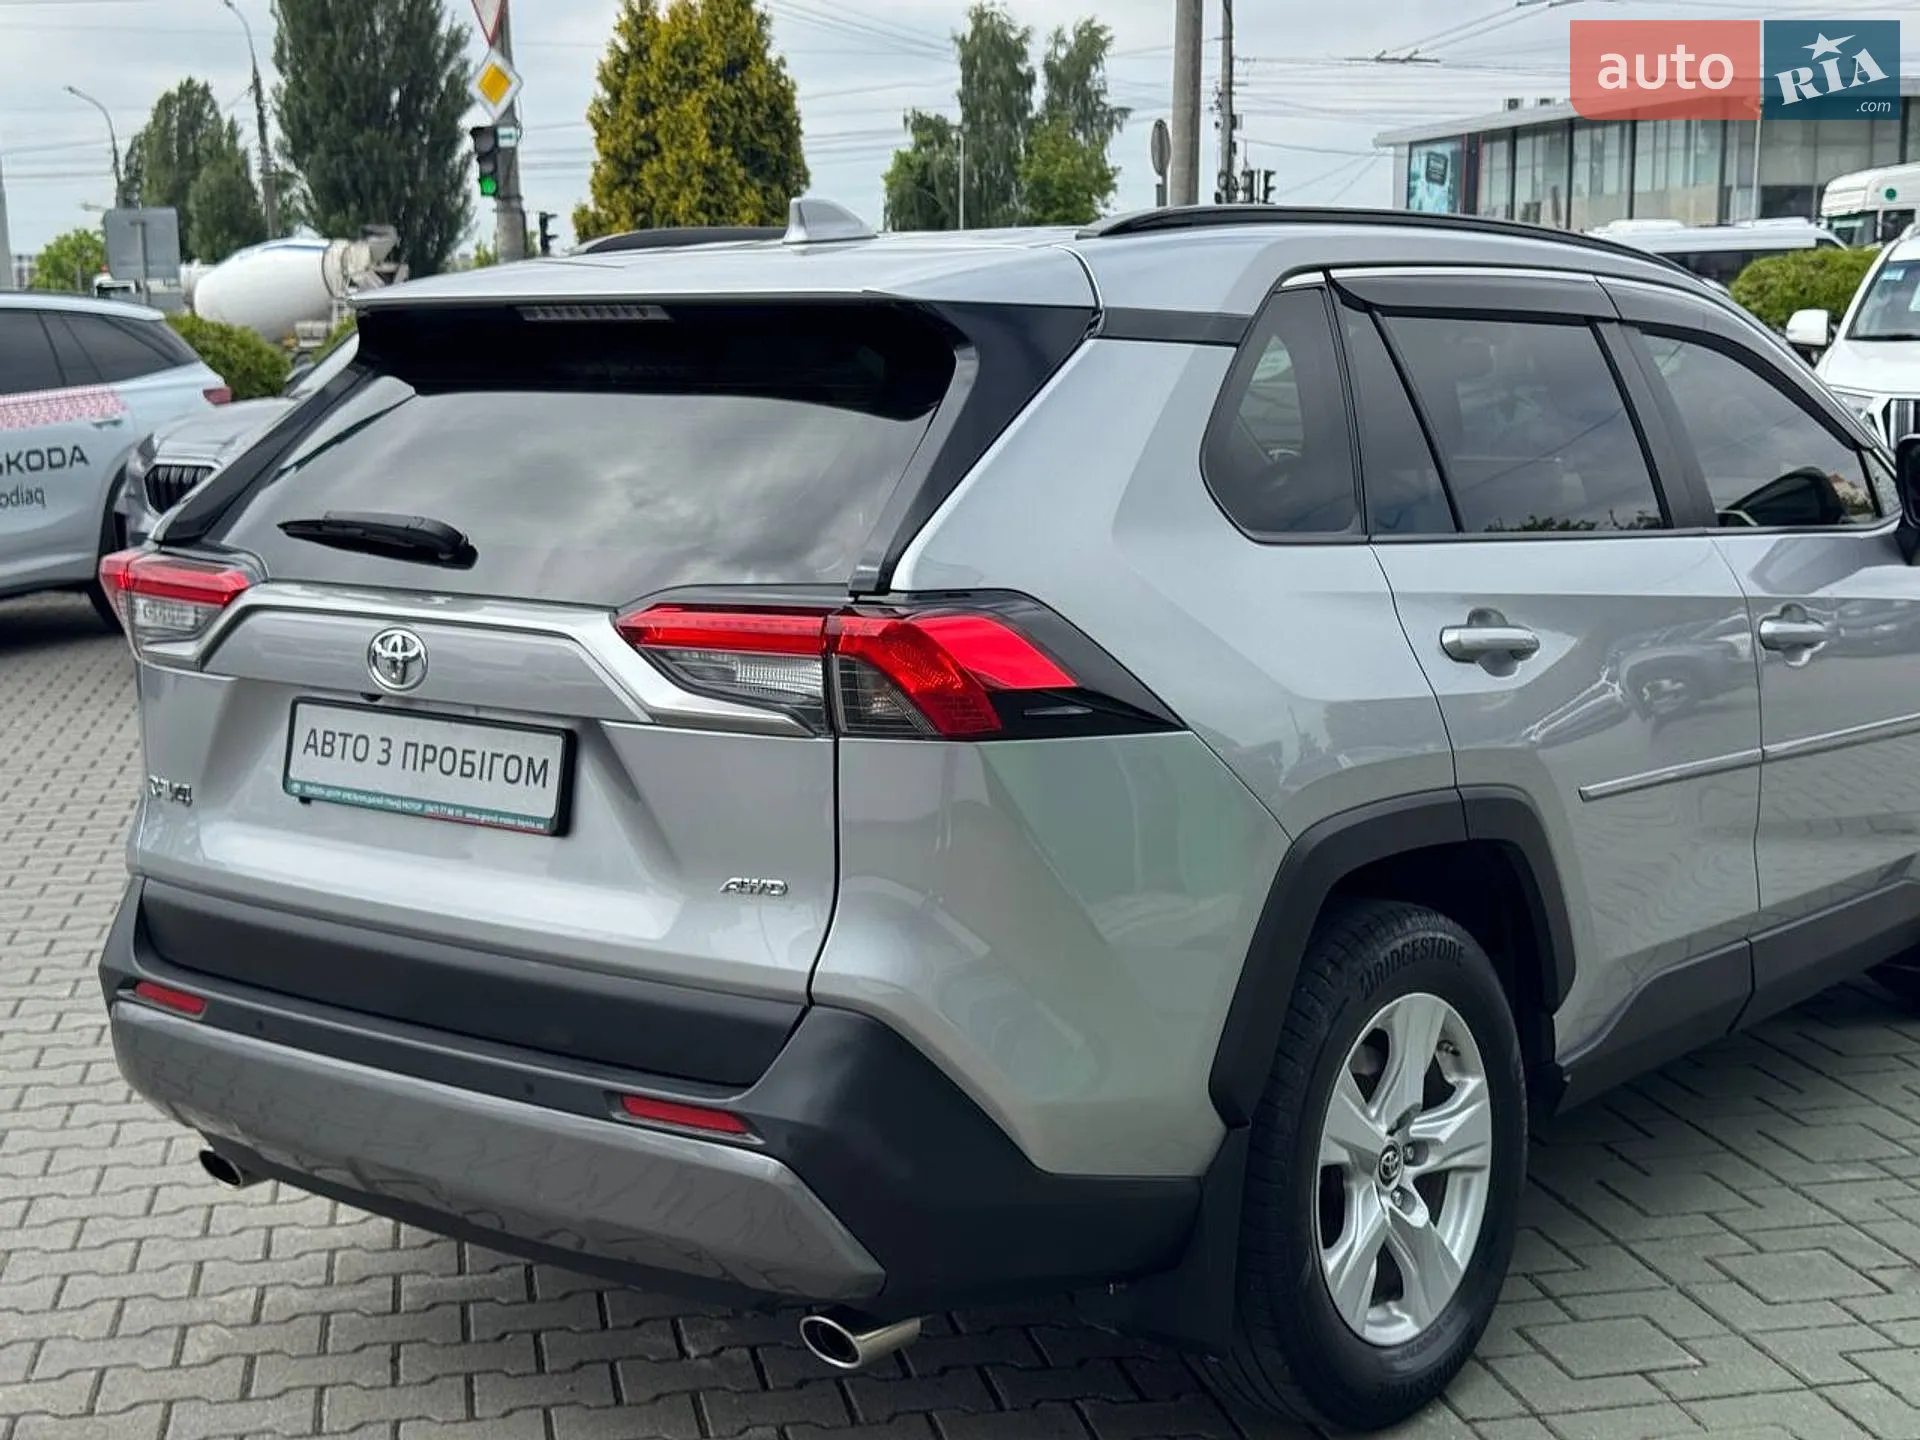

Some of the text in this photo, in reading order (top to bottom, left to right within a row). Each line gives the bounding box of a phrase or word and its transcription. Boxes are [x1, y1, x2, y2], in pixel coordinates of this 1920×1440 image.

[302, 727, 370, 763] АВТО
[401, 741, 550, 789] ПРОБІГОМ
[720, 877, 788, 897] AWD
